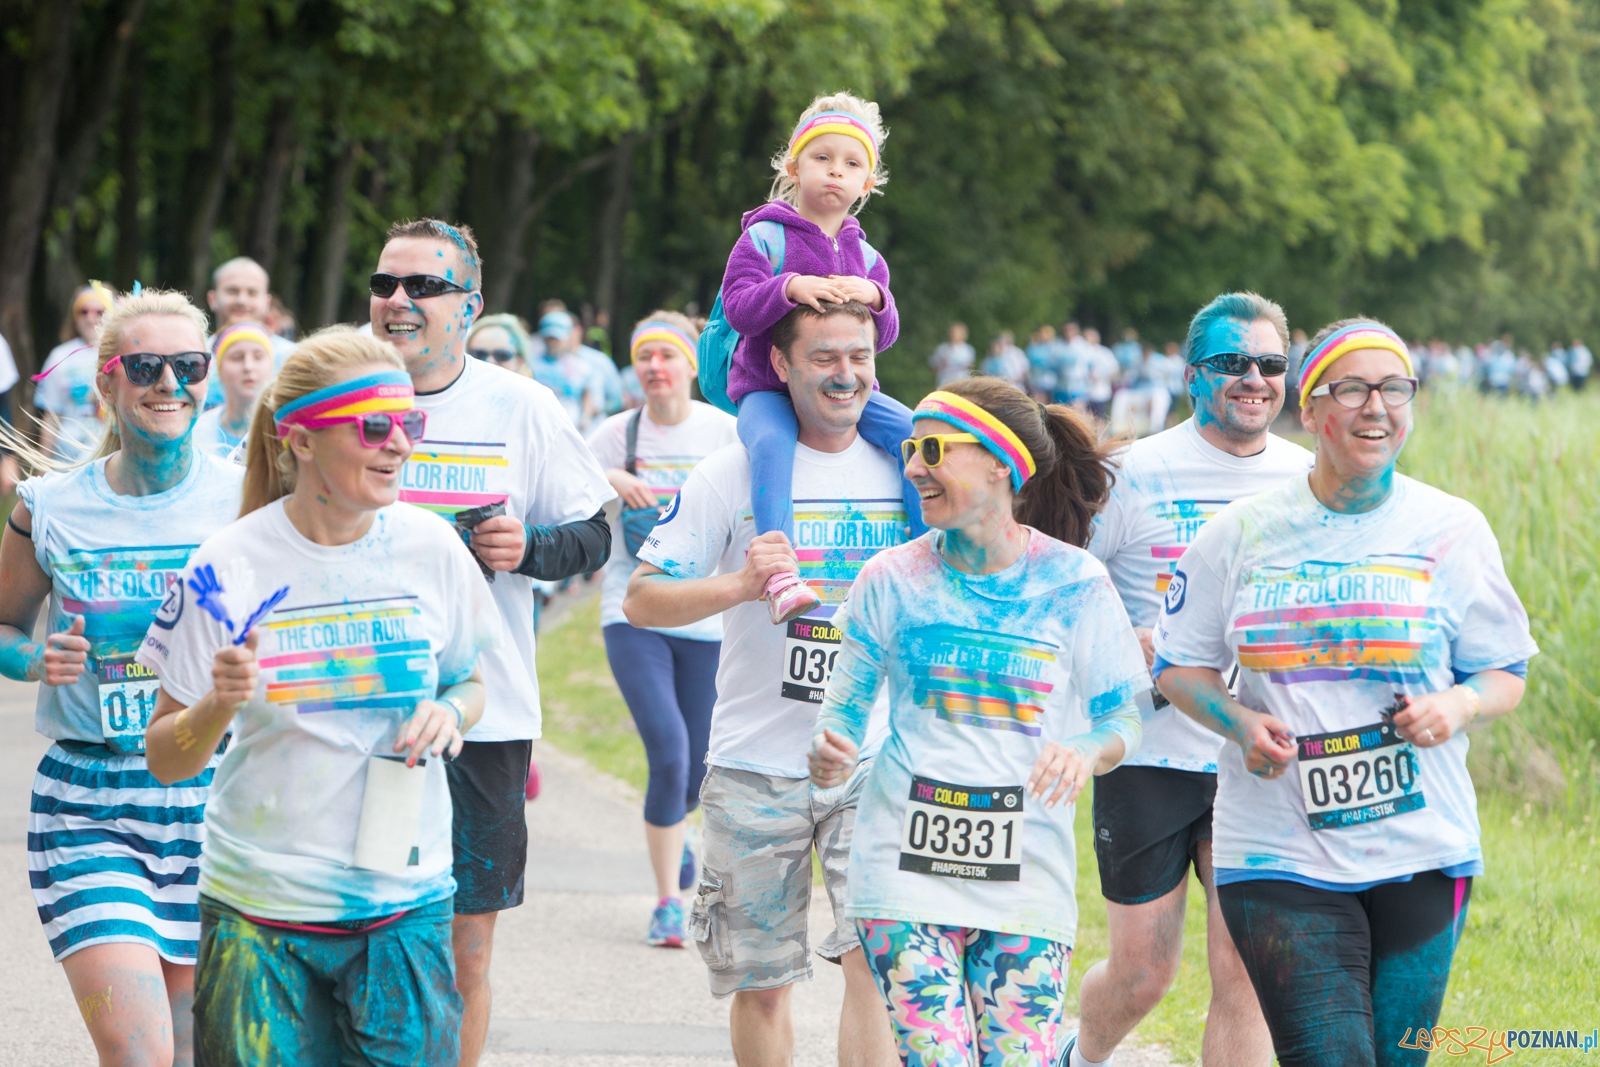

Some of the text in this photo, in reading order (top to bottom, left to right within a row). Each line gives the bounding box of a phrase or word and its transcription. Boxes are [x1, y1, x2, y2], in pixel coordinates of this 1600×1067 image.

[398, 462, 442, 490] LOR
[799, 521, 857, 547] COLOR
[1254, 582, 1291, 608] THE
[1296, 574, 1367, 604] COLOR
[275, 627, 309, 651] THE
[311, 621, 369, 648] COLOR
[794, 623, 812, 638] THE
[104, 664, 126, 680] THE
[1303, 740, 1325, 756] THE
[1324, 733, 1361, 754] COLOR
[1307, 750, 1415, 808] 03260
[917, 783, 936, 801] THE
[934, 787, 969, 807] COLOR
[909, 810, 1014, 859] 03331
[931, 861, 988, 878] #HAPPIEST5K
